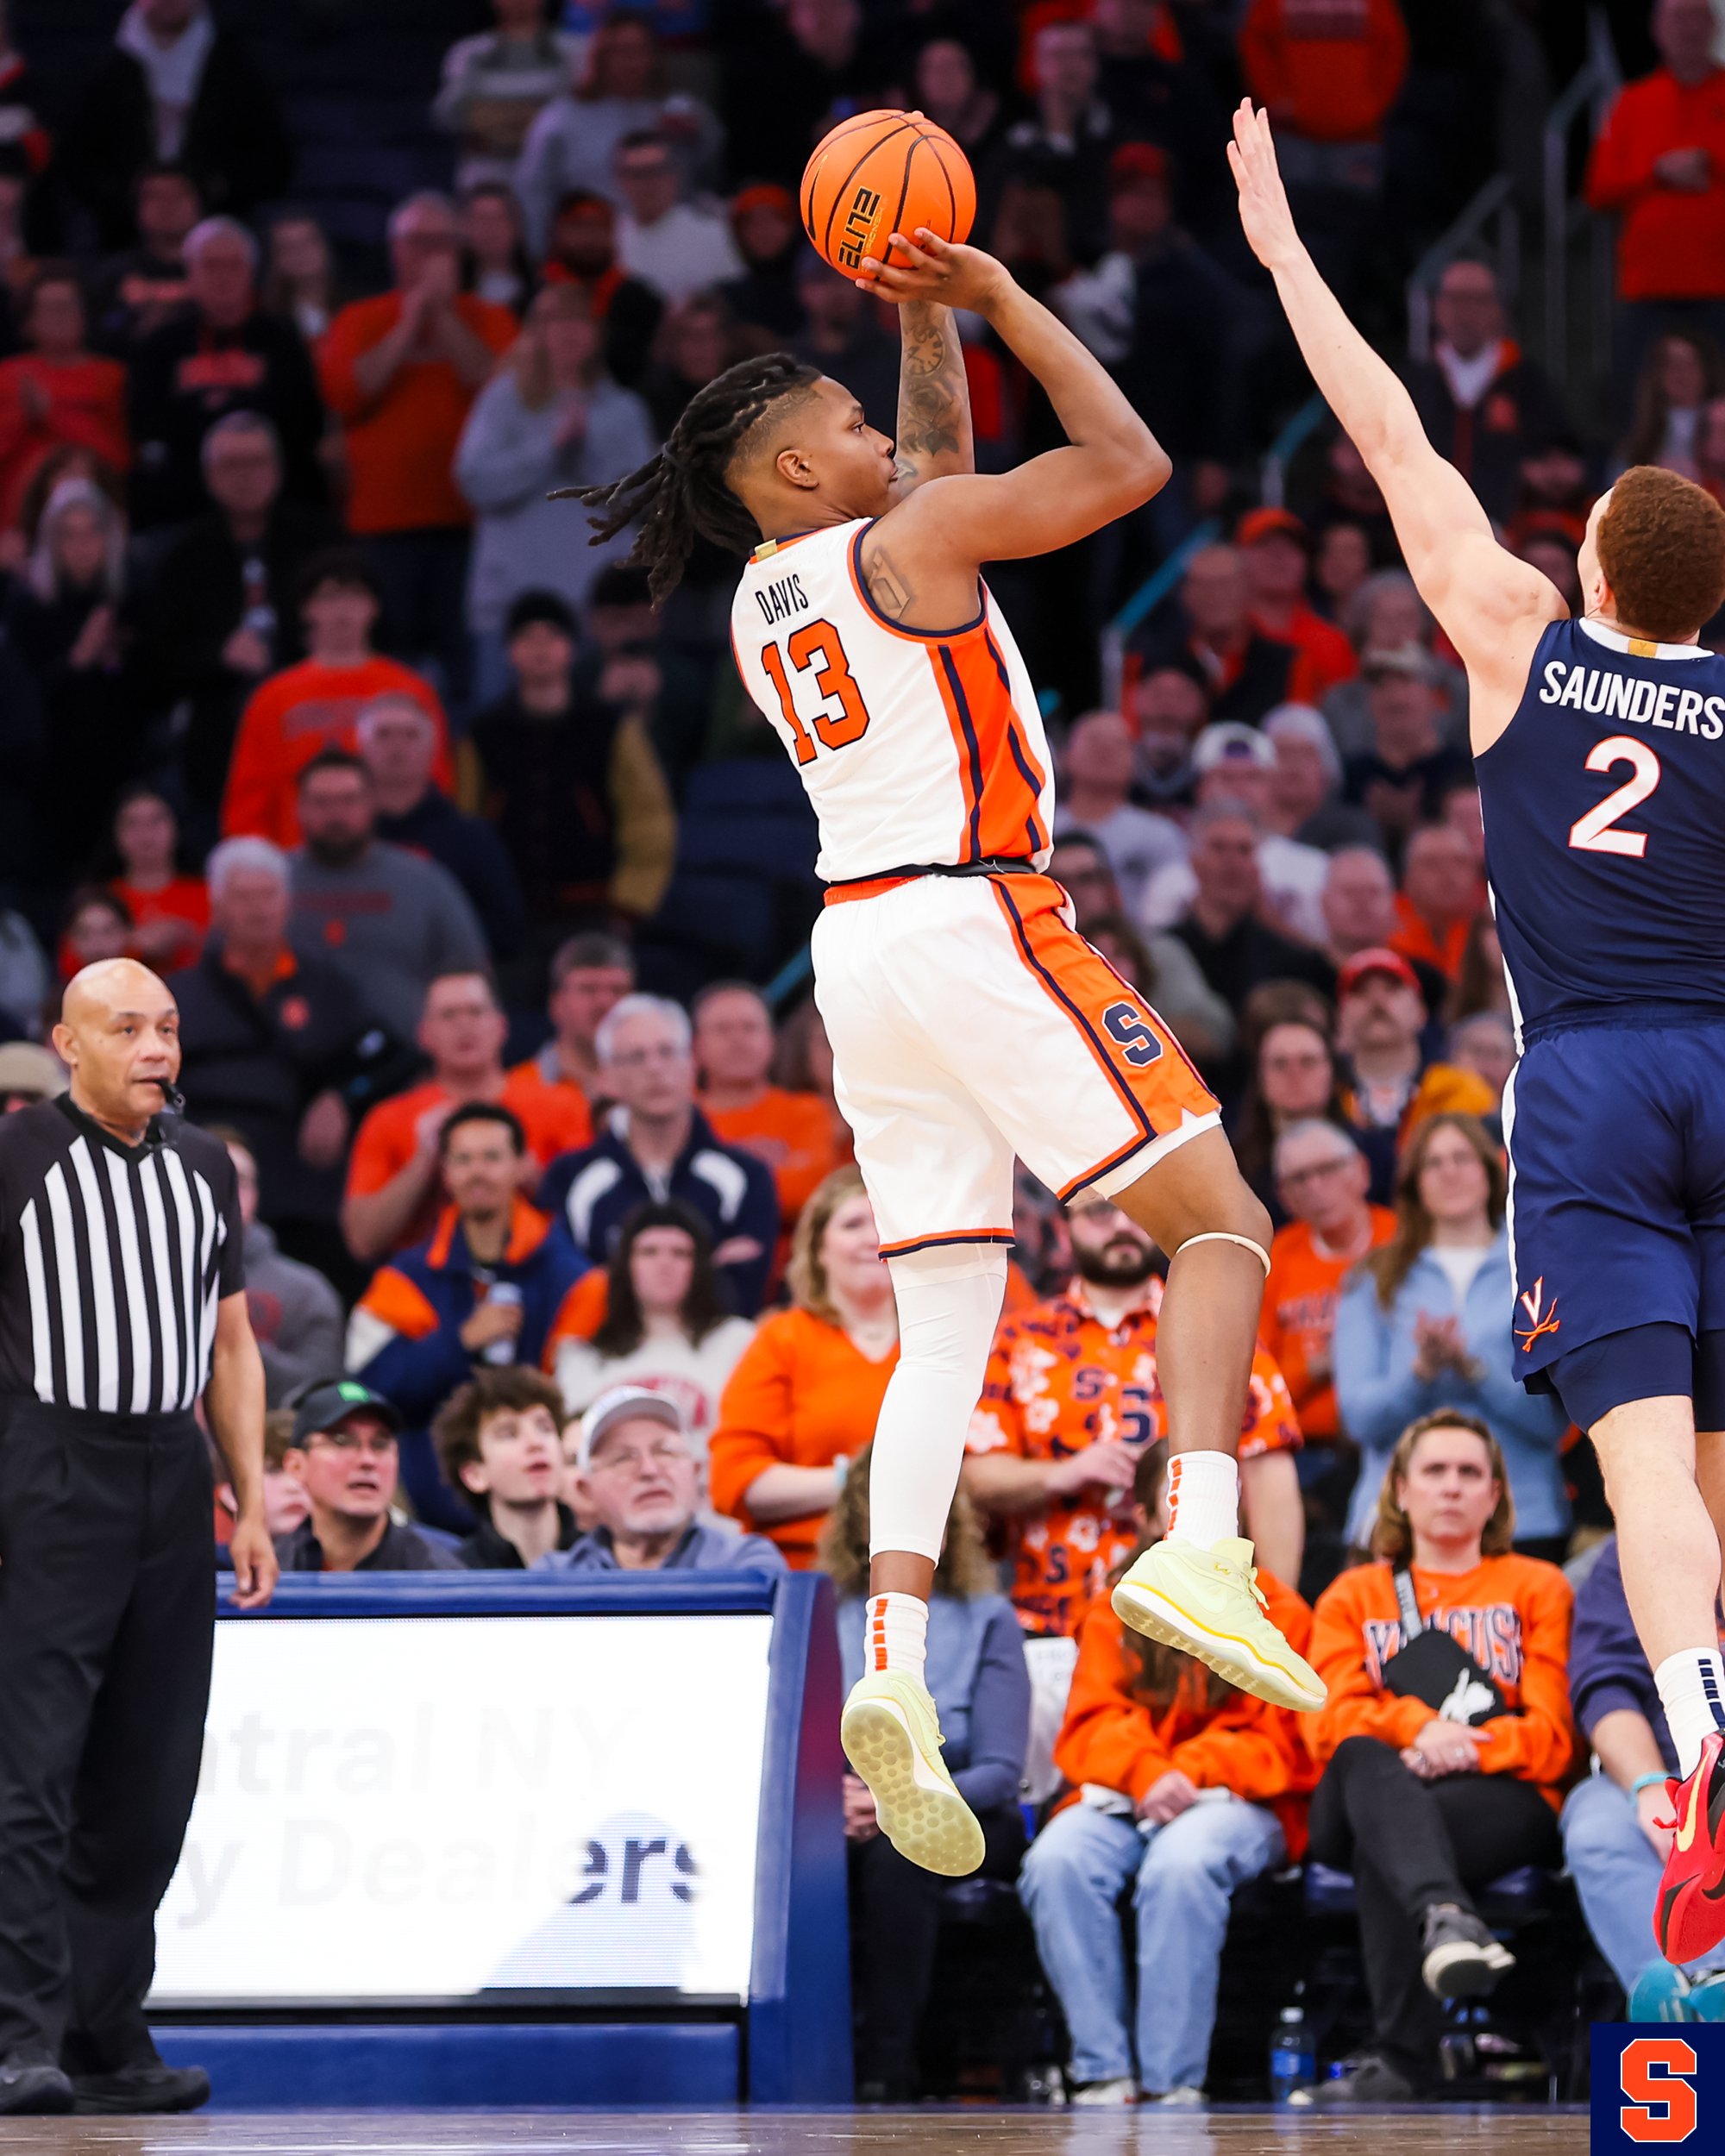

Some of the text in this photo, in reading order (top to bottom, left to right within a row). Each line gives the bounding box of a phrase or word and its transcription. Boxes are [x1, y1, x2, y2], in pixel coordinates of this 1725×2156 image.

[837, 185, 881, 271] ELITE
[755, 573, 809, 625] DAVIS
[761, 617, 870, 767] 13
[1539, 661, 1725, 740] SAUNDERS
[1568, 734, 1662, 858] 2
[1101, 1000, 1164, 1068] S
[200, 1700, 642, 1795] tral NY
[276, 1810, 731, 1908] Dealers
